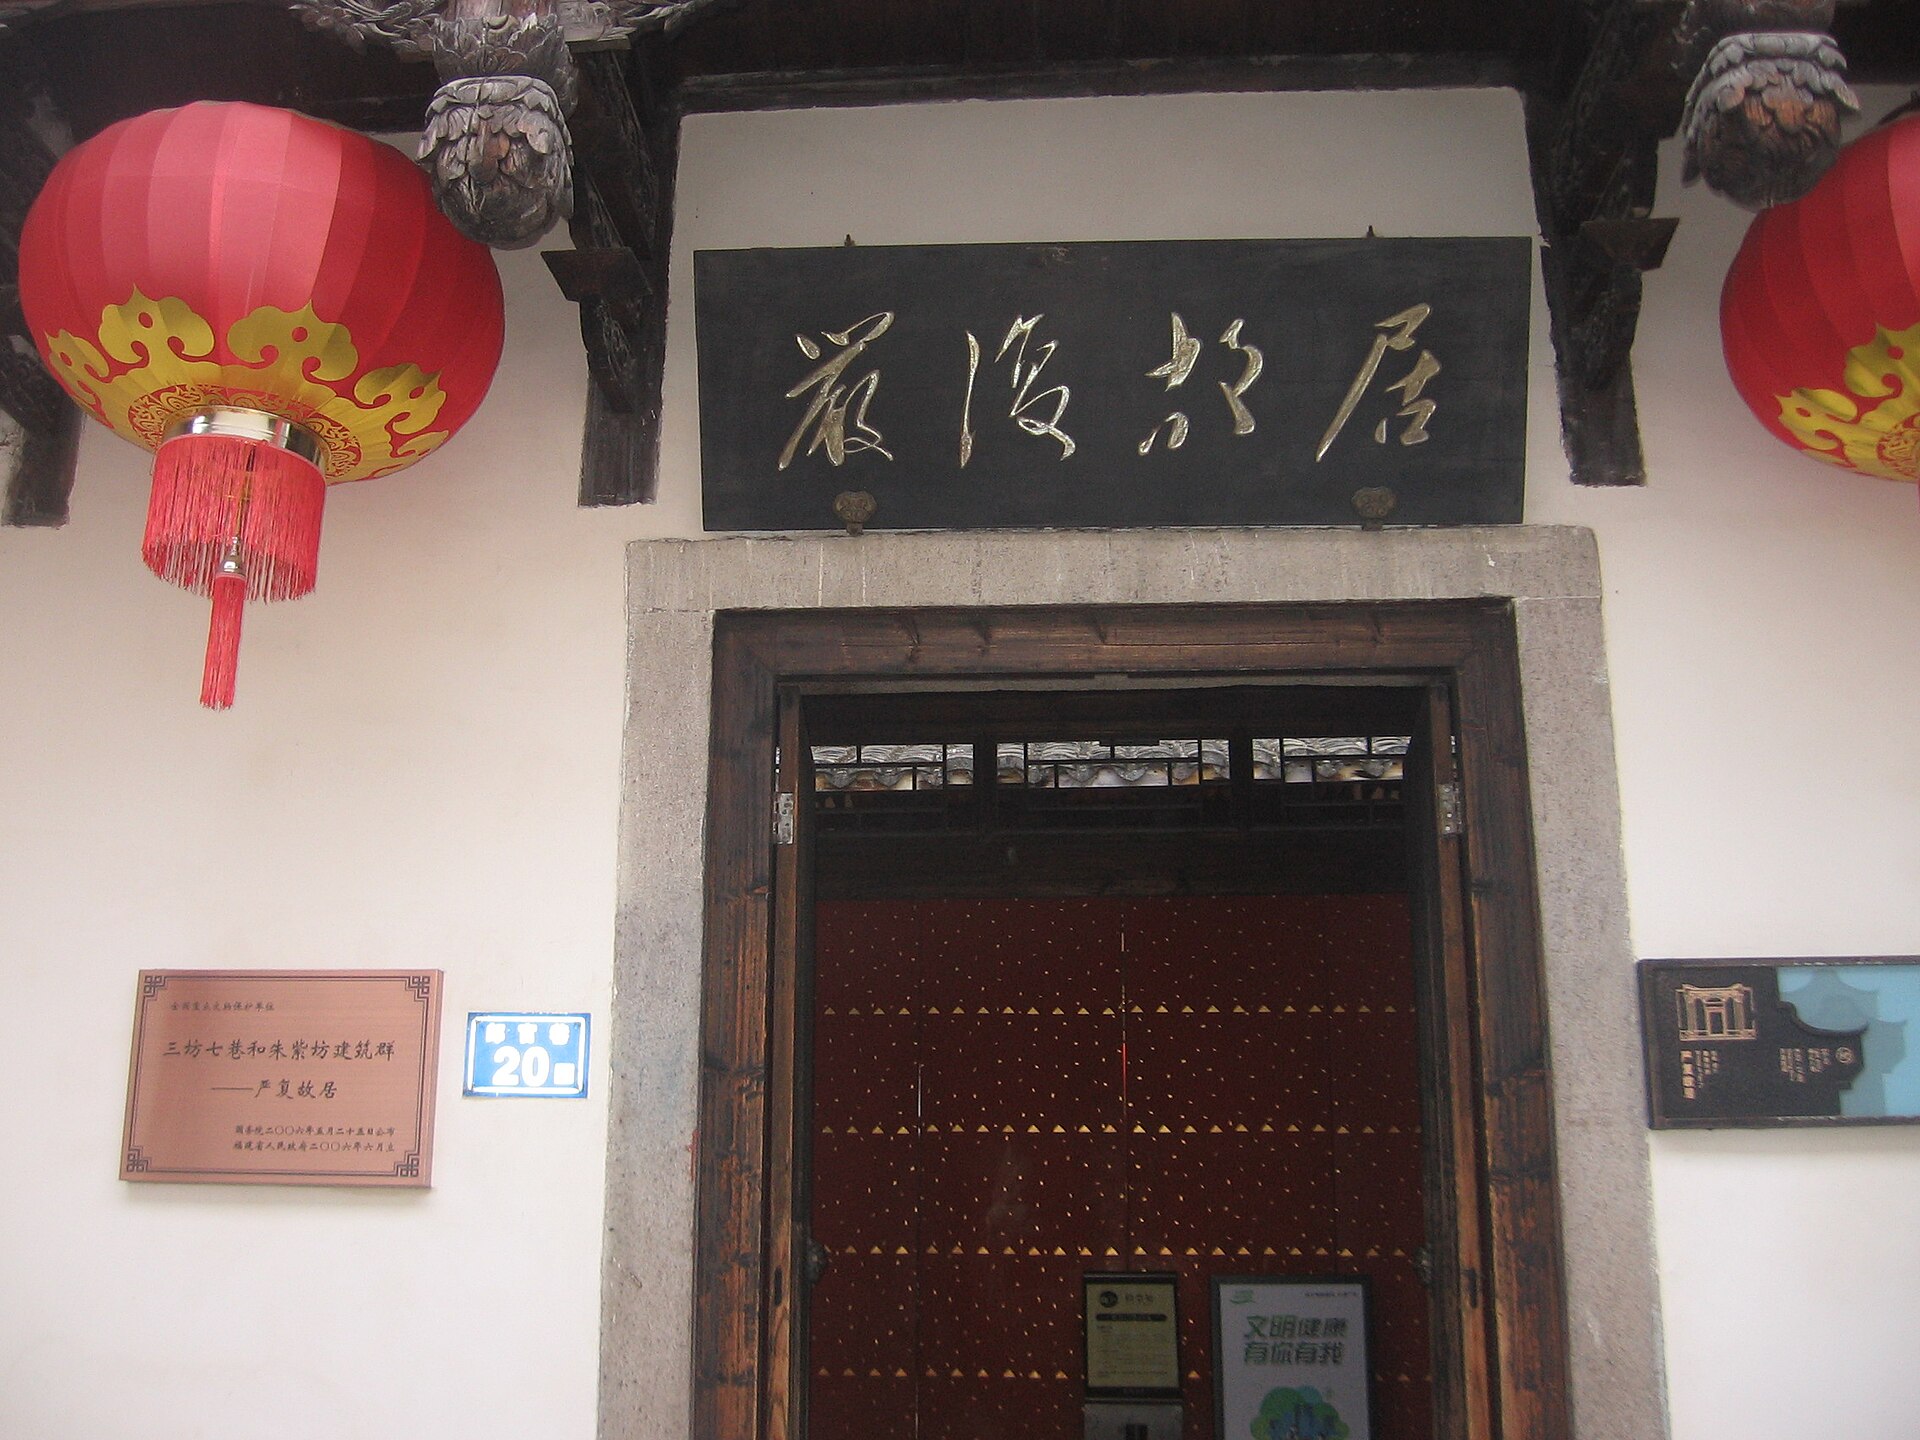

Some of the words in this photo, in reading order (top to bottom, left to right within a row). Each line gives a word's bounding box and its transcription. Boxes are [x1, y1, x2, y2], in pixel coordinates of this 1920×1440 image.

[162, 1039, 396, 1062] 三坊七巷和朱紫坊建筑群
[1244, 1315, 1347, 1338] 文明健康
[1244, 1341, 1344, 1364] 有你有我
